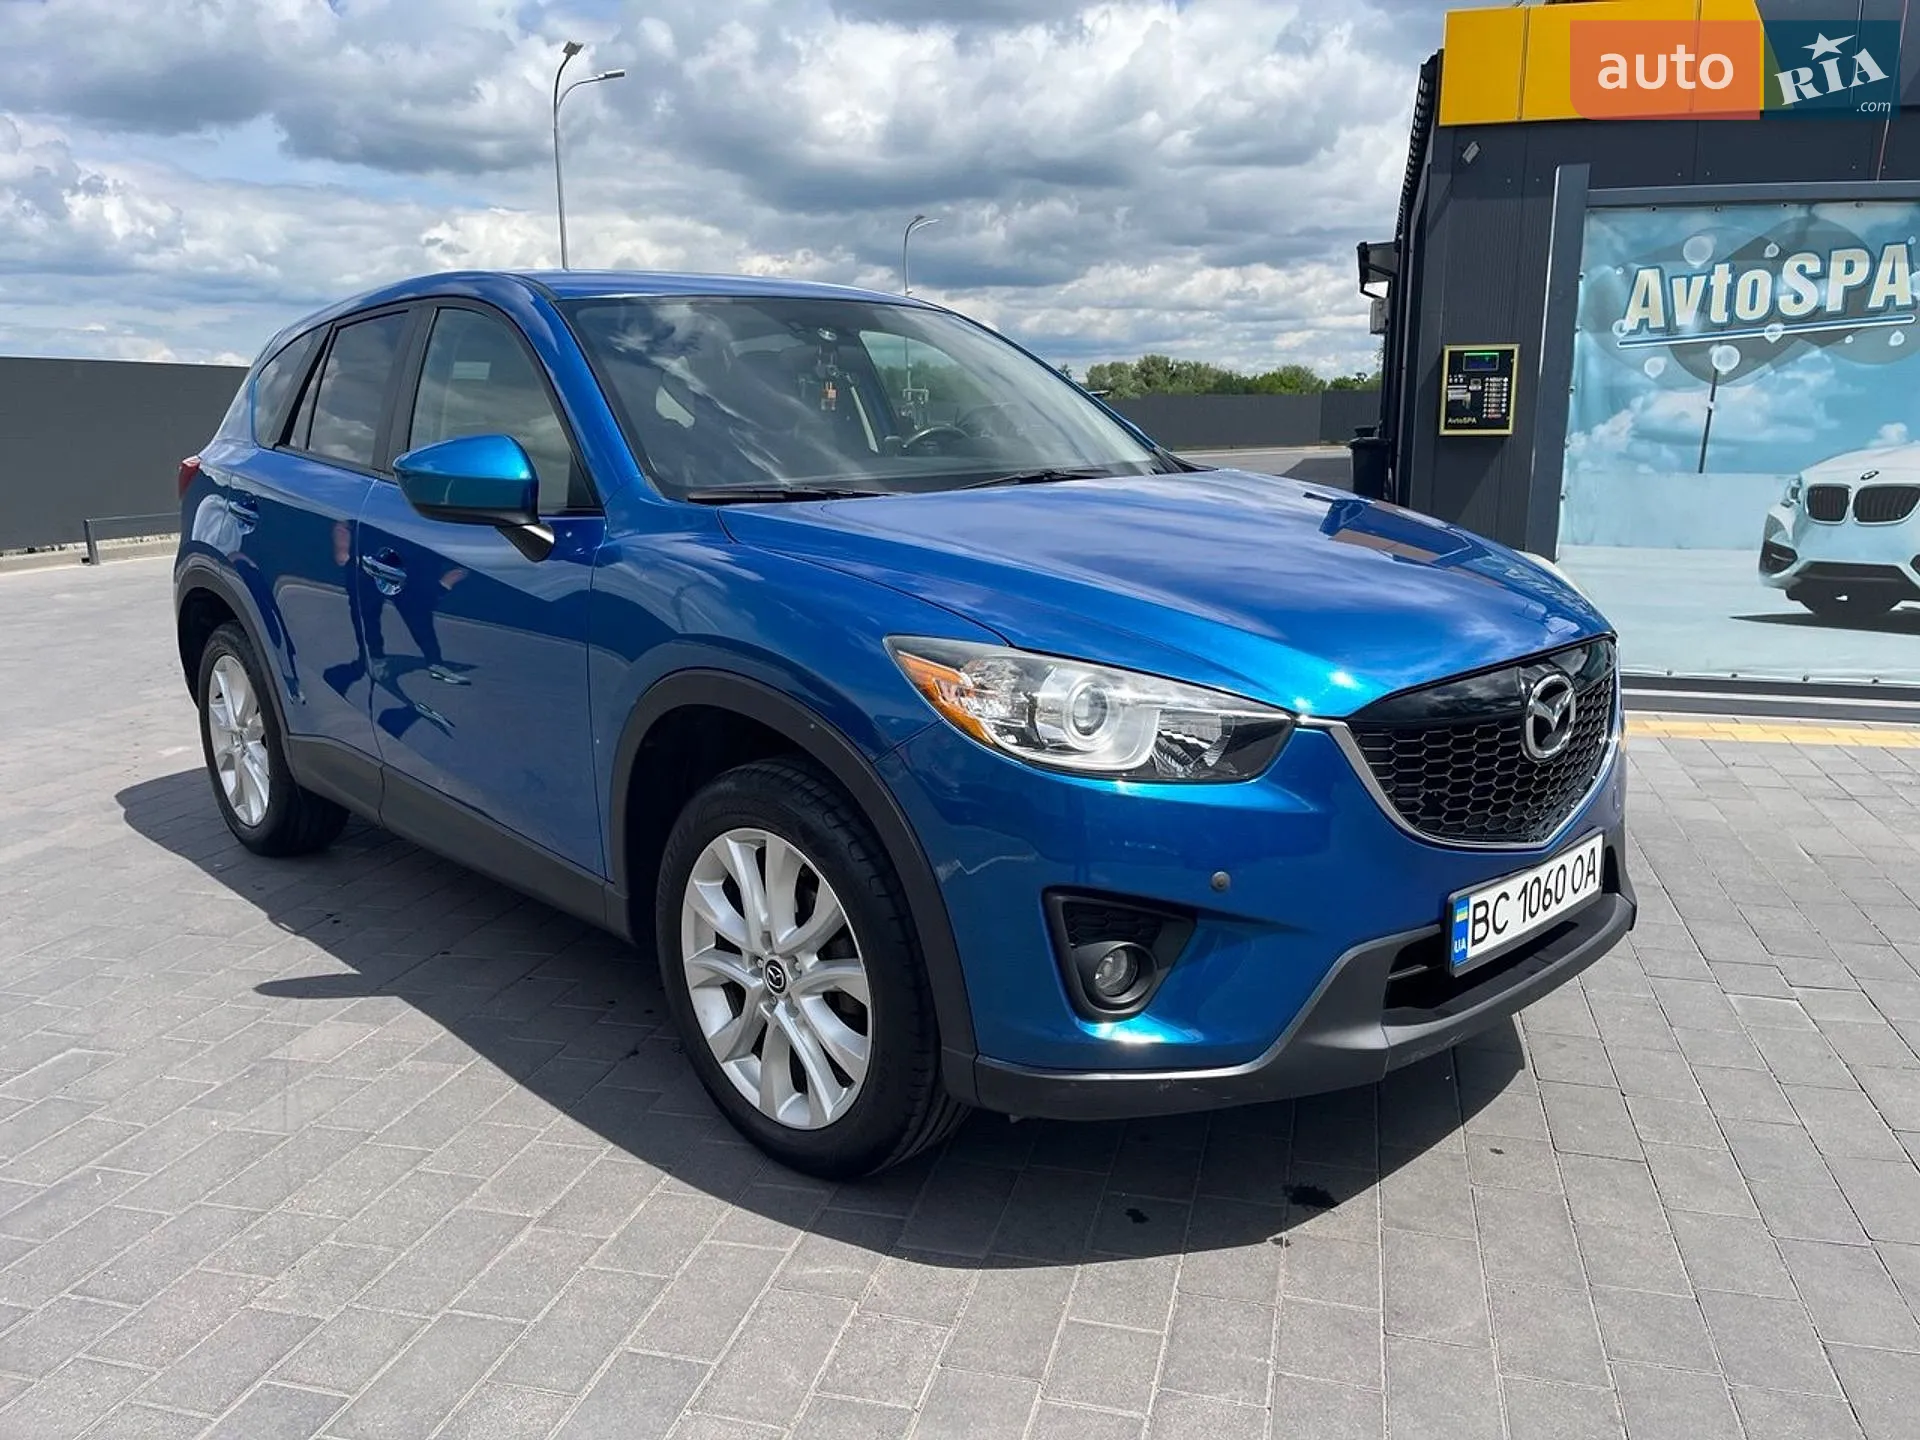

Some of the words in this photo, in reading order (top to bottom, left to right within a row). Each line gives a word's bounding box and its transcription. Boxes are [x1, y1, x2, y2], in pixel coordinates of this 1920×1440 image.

[1624, 242, 1913, 330] AvtoSPA
[1471, 891, 1510, 947] BC
[1517, 863, 1567, 923] 1060
[1571, 847, 1597, 895] OA
[1454, 937, 1467, 953] UA
